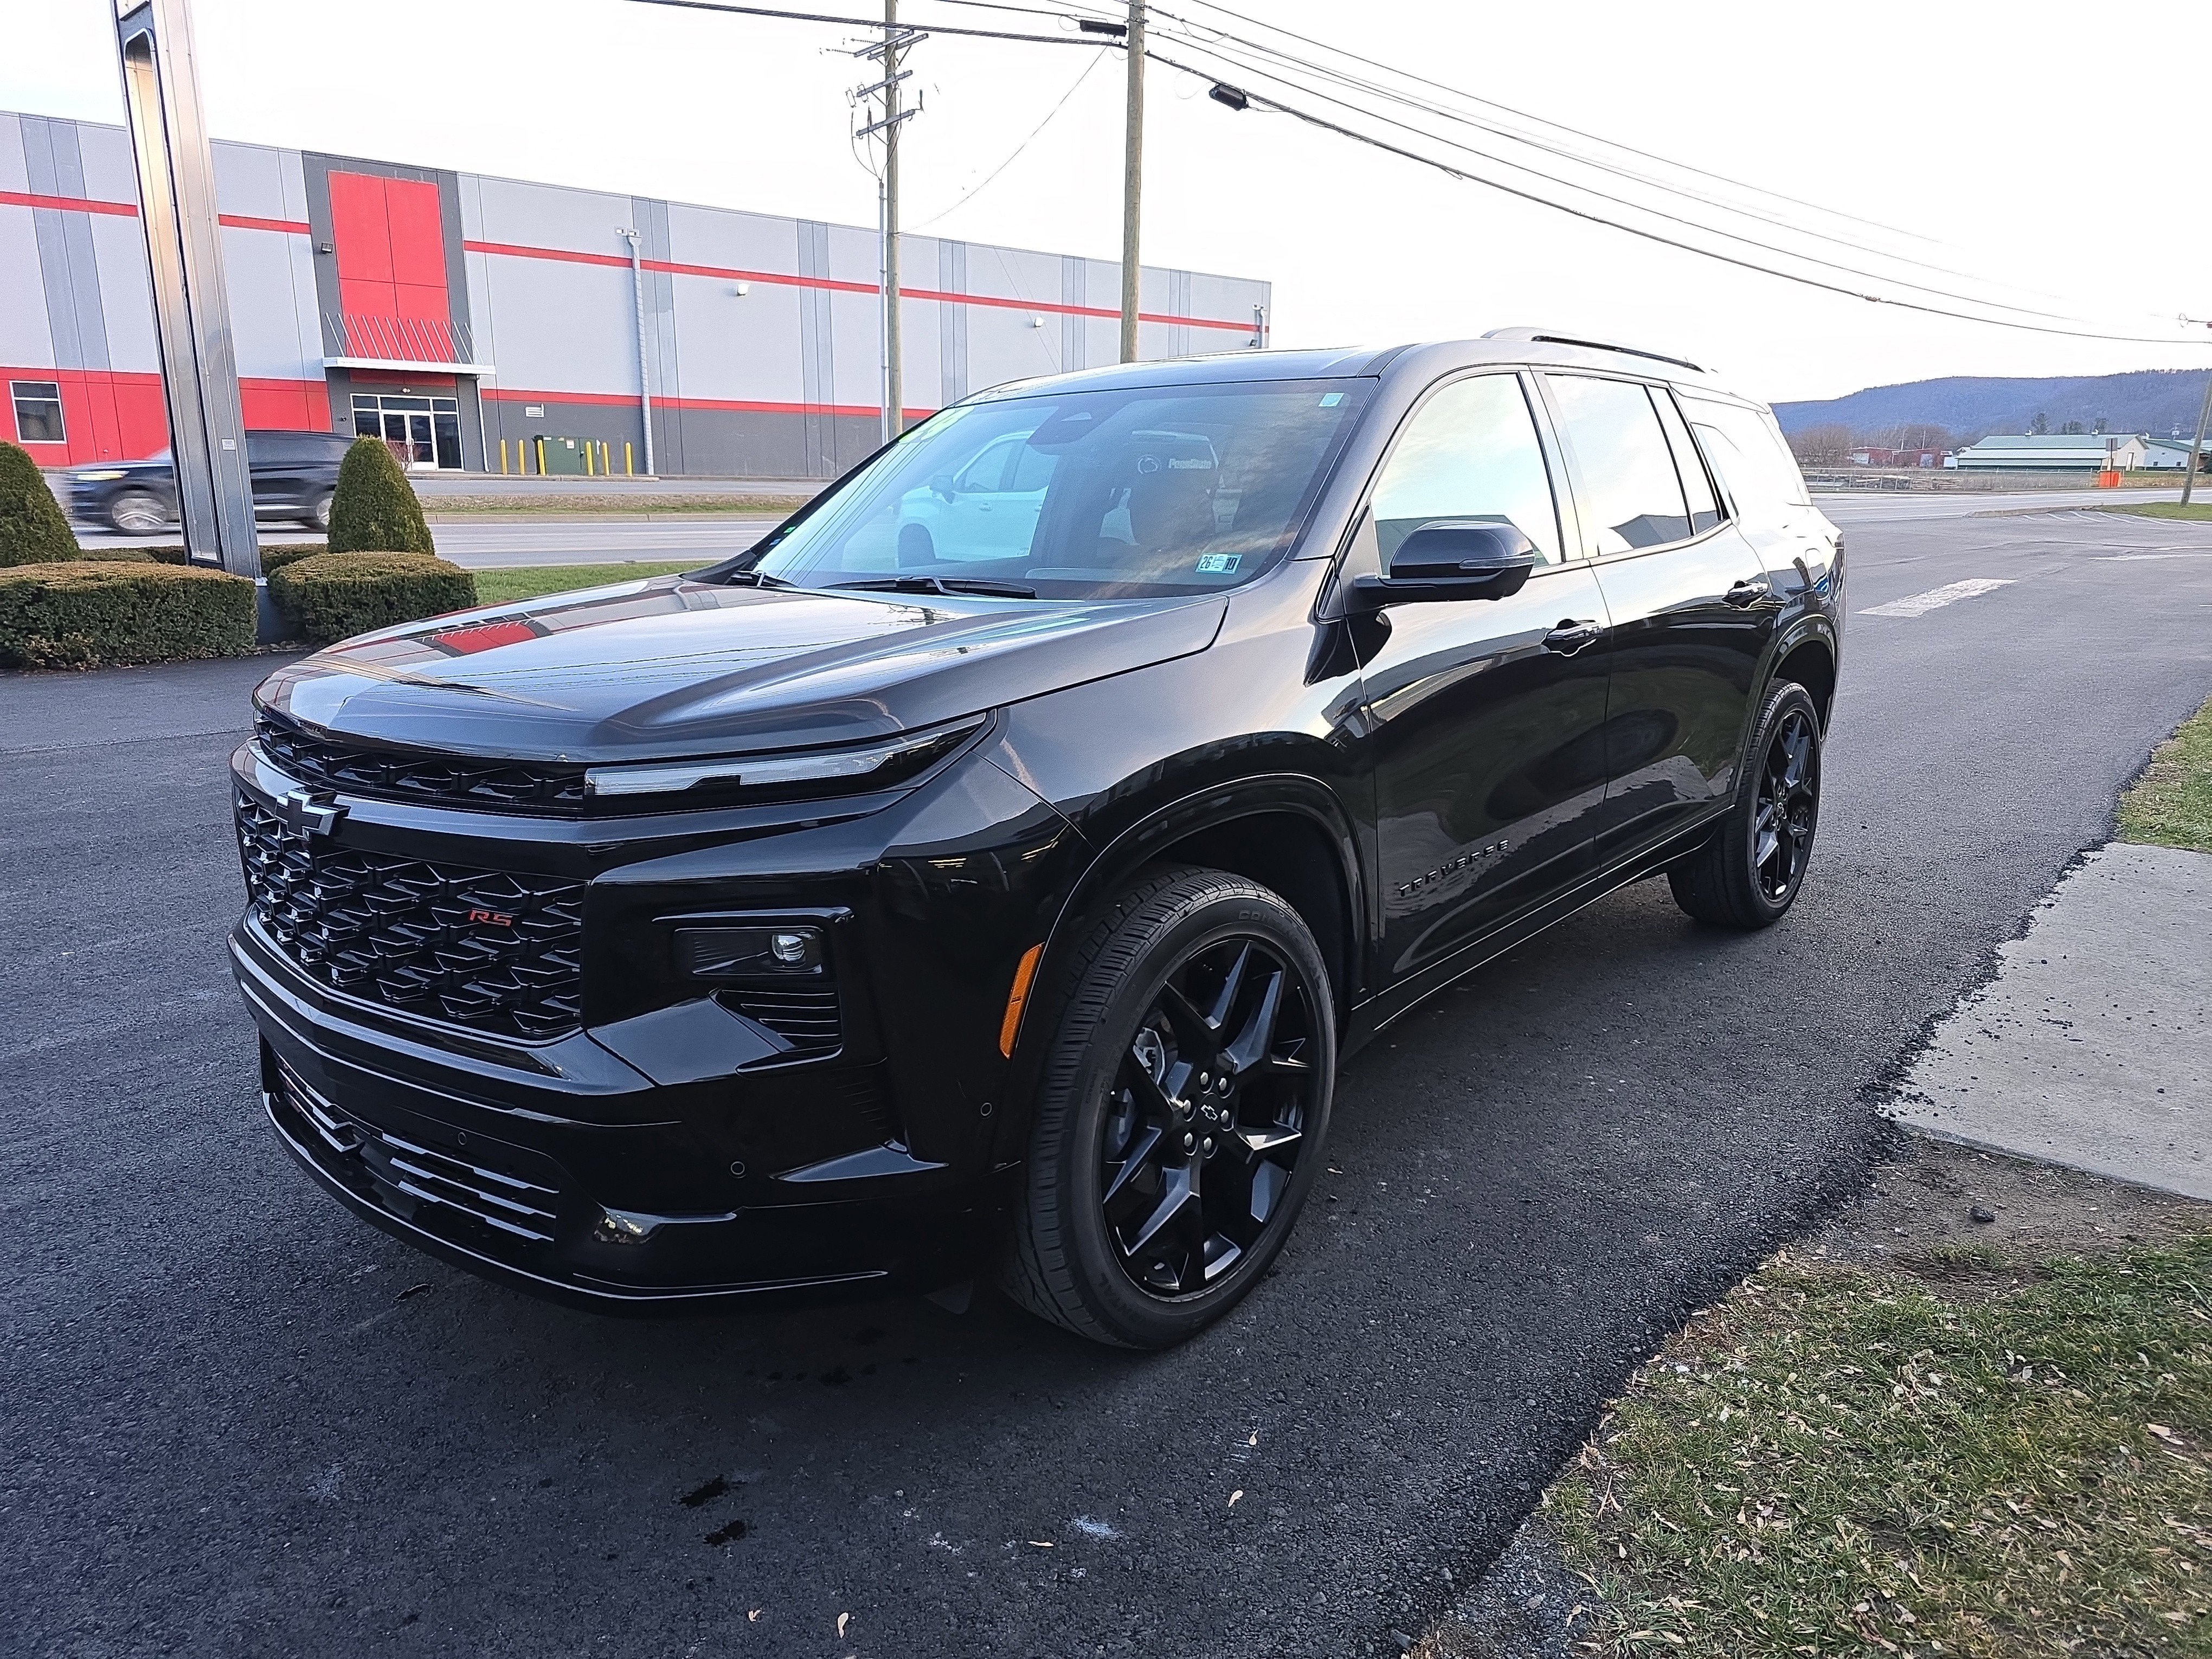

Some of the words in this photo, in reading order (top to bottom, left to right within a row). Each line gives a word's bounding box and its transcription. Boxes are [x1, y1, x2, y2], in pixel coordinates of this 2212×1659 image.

[1200, 556, 1213, 569] 26
[1225, 557, 1237, 570] 10
[1398, 839, 1509, 897] TRAVERSE
[470, 910, 513, 927] RS
